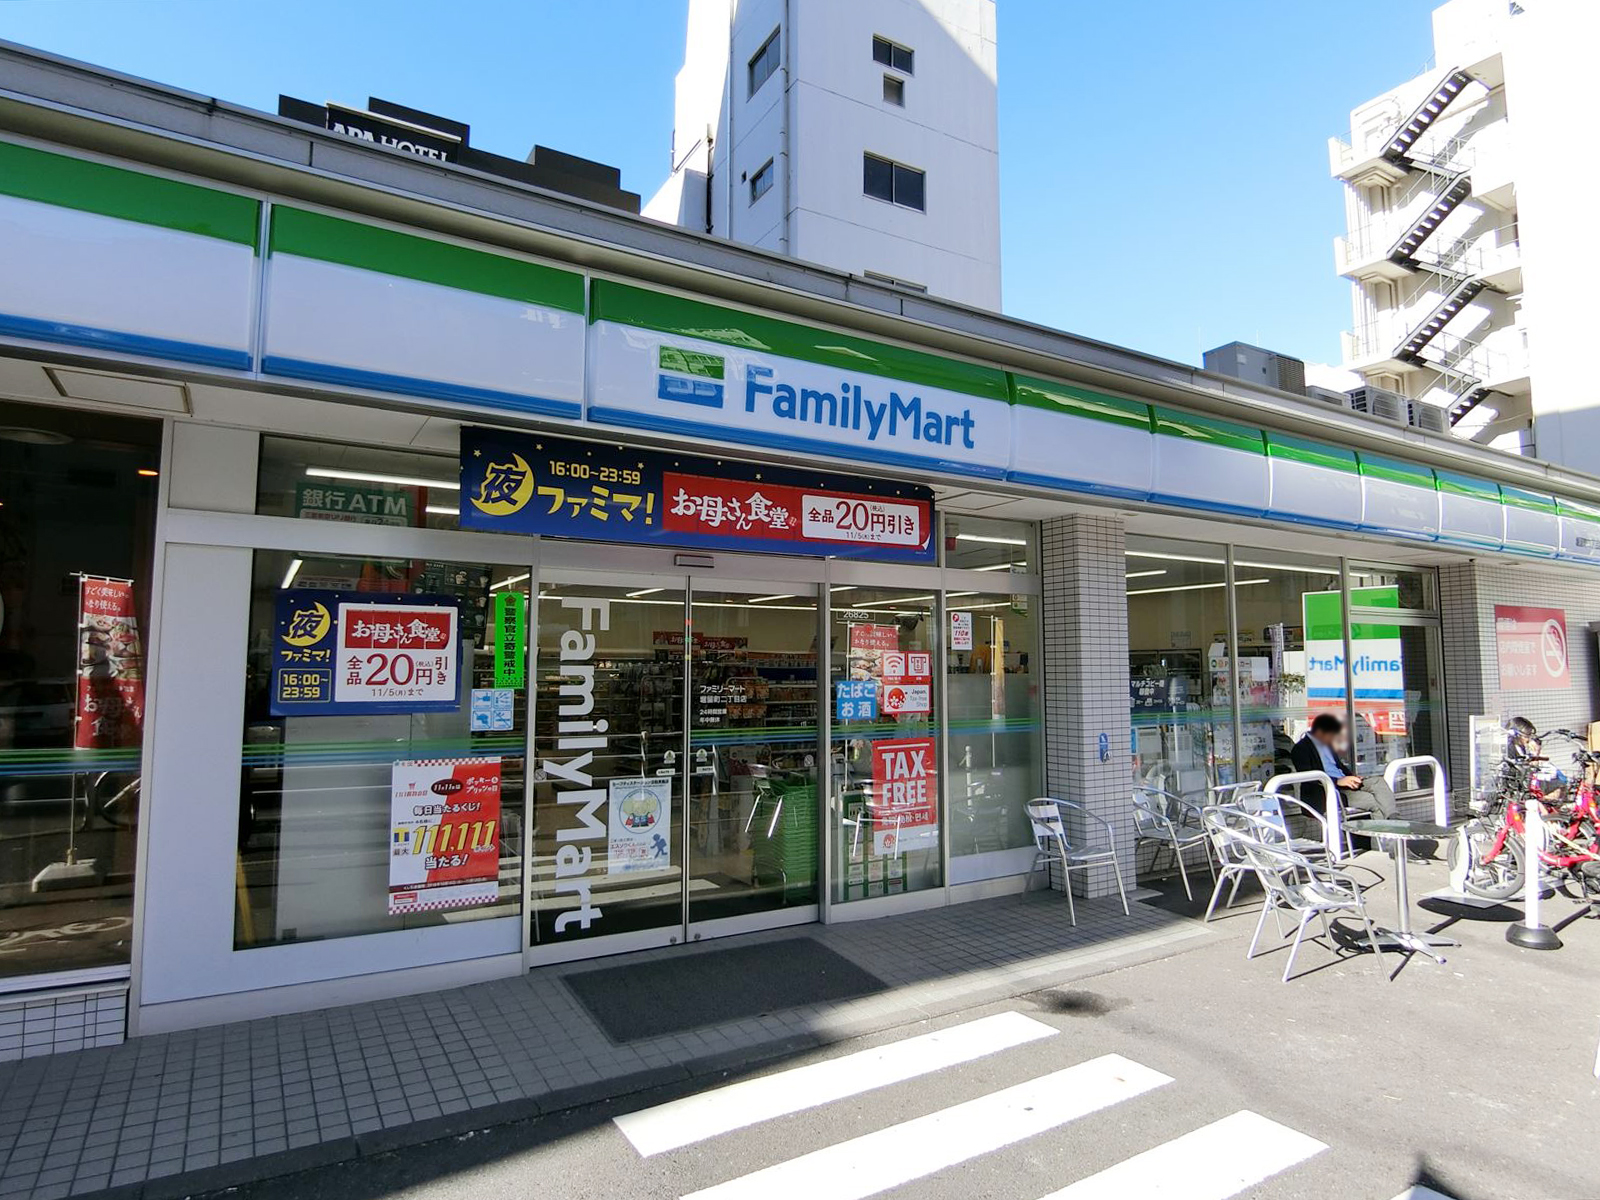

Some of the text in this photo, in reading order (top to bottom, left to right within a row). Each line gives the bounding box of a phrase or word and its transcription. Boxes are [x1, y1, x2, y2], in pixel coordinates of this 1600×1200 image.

[745, 363, 975, 449] FamilyMart
[670, 487, 790, 531] お母さん食堂
[351, 618, 442, 645] お母さん食堂
[282, 686, 320, 699] 23:59
[700, 684, 746, 694] ファミリーマート
[837, 683, 876, 699] たばこ
[841, 701, 872, 718] お酒
[543, 597, 611, 933] FamilyMart
[881, 750, 928, 780] TAX
[882, 780, 928, 808] FREE
[425, 853, 469, 870] 当たる!
